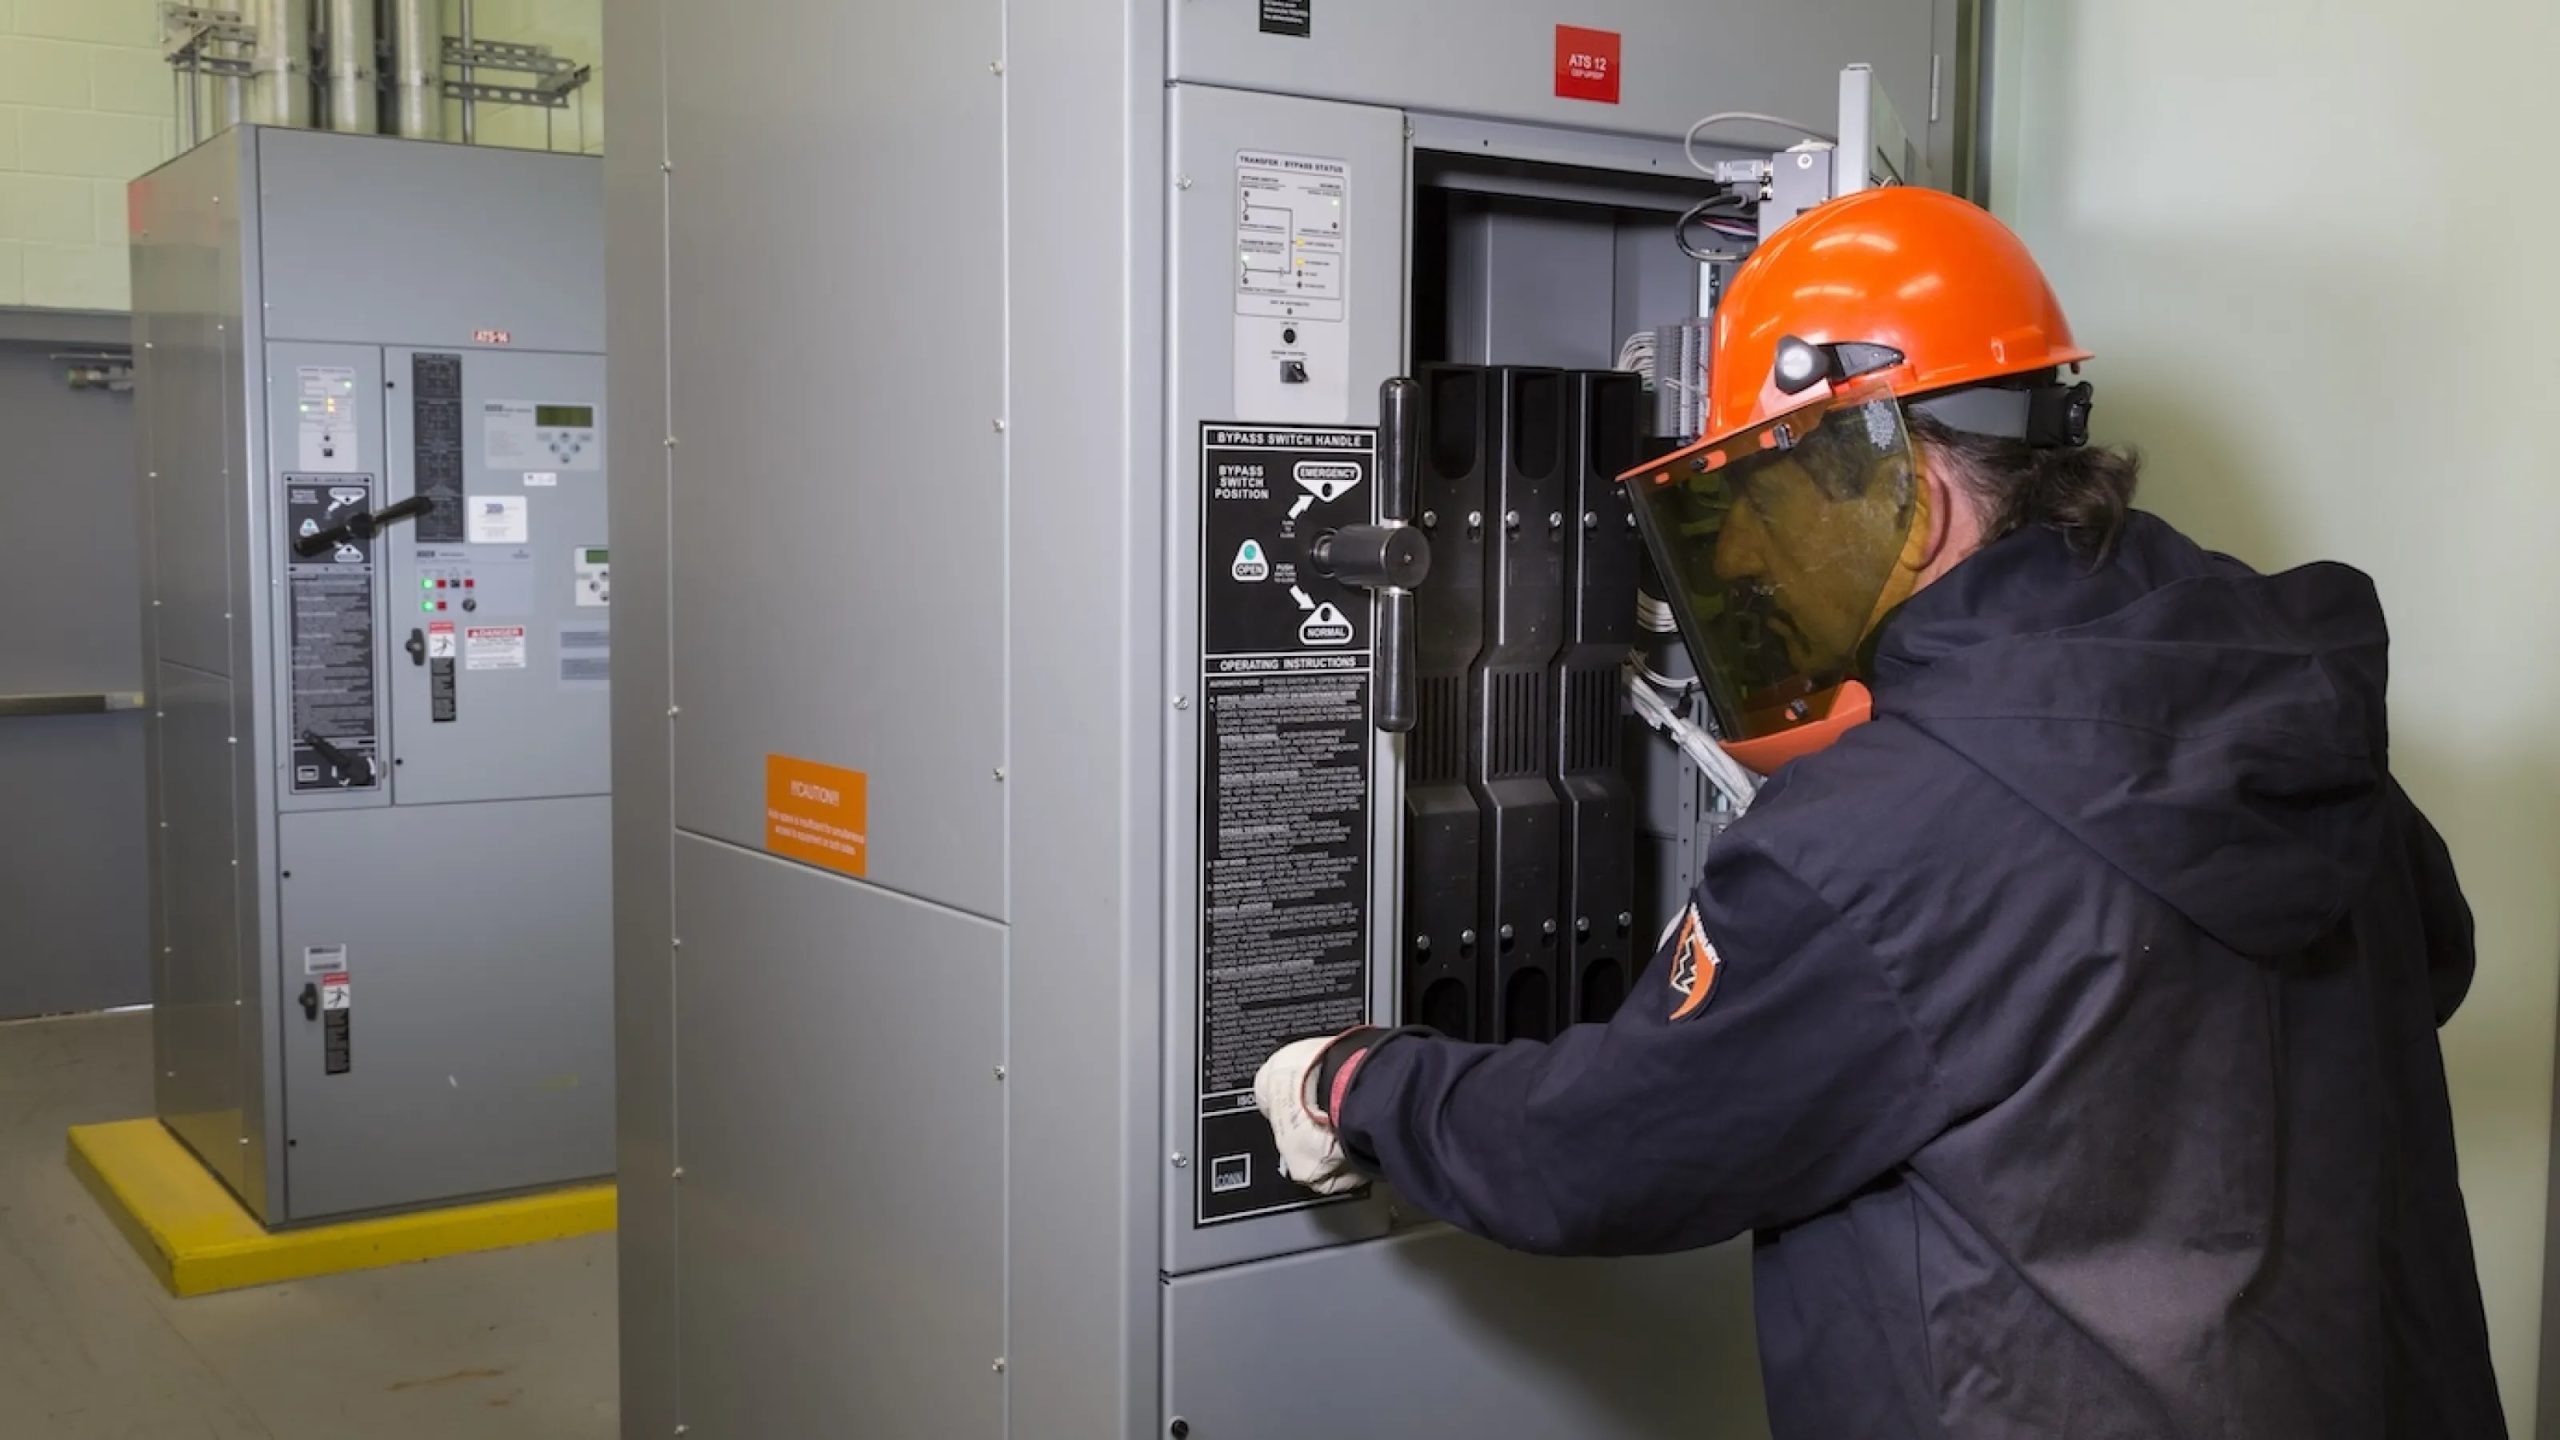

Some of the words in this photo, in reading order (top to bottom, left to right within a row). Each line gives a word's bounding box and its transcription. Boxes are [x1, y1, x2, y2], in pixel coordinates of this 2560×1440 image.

[1568, 53, 1592, 69] ATS
[1594, 57, 1607, 71] 12
[1240, 155, 1279, 167] TRANSFER
[1284, 160, 1312, 170] BYPASS
[1314, 163, 1343, 173] STATUS
[1216, 431, 1264, 444] BYPASS
[1267, 433, 1312, 445] SWITCH
[1315, 434, 1361, 447] HANDLE
[1218, 465, 1264, 477] BYPASS
[1300, 467, 1356, 479] EMERGENCY
[1220, 477, 1264, 488] SWITCH
[1214, 488, 1270, 499] POSITION
[1236, 563, 1263, 576] OPEN
[1307, 626, 1346, 638] NORMAL
[1220, 659, 1279, 671] OPERATING
[1283, 656, 1357, 669] INSTRUCTIONS
